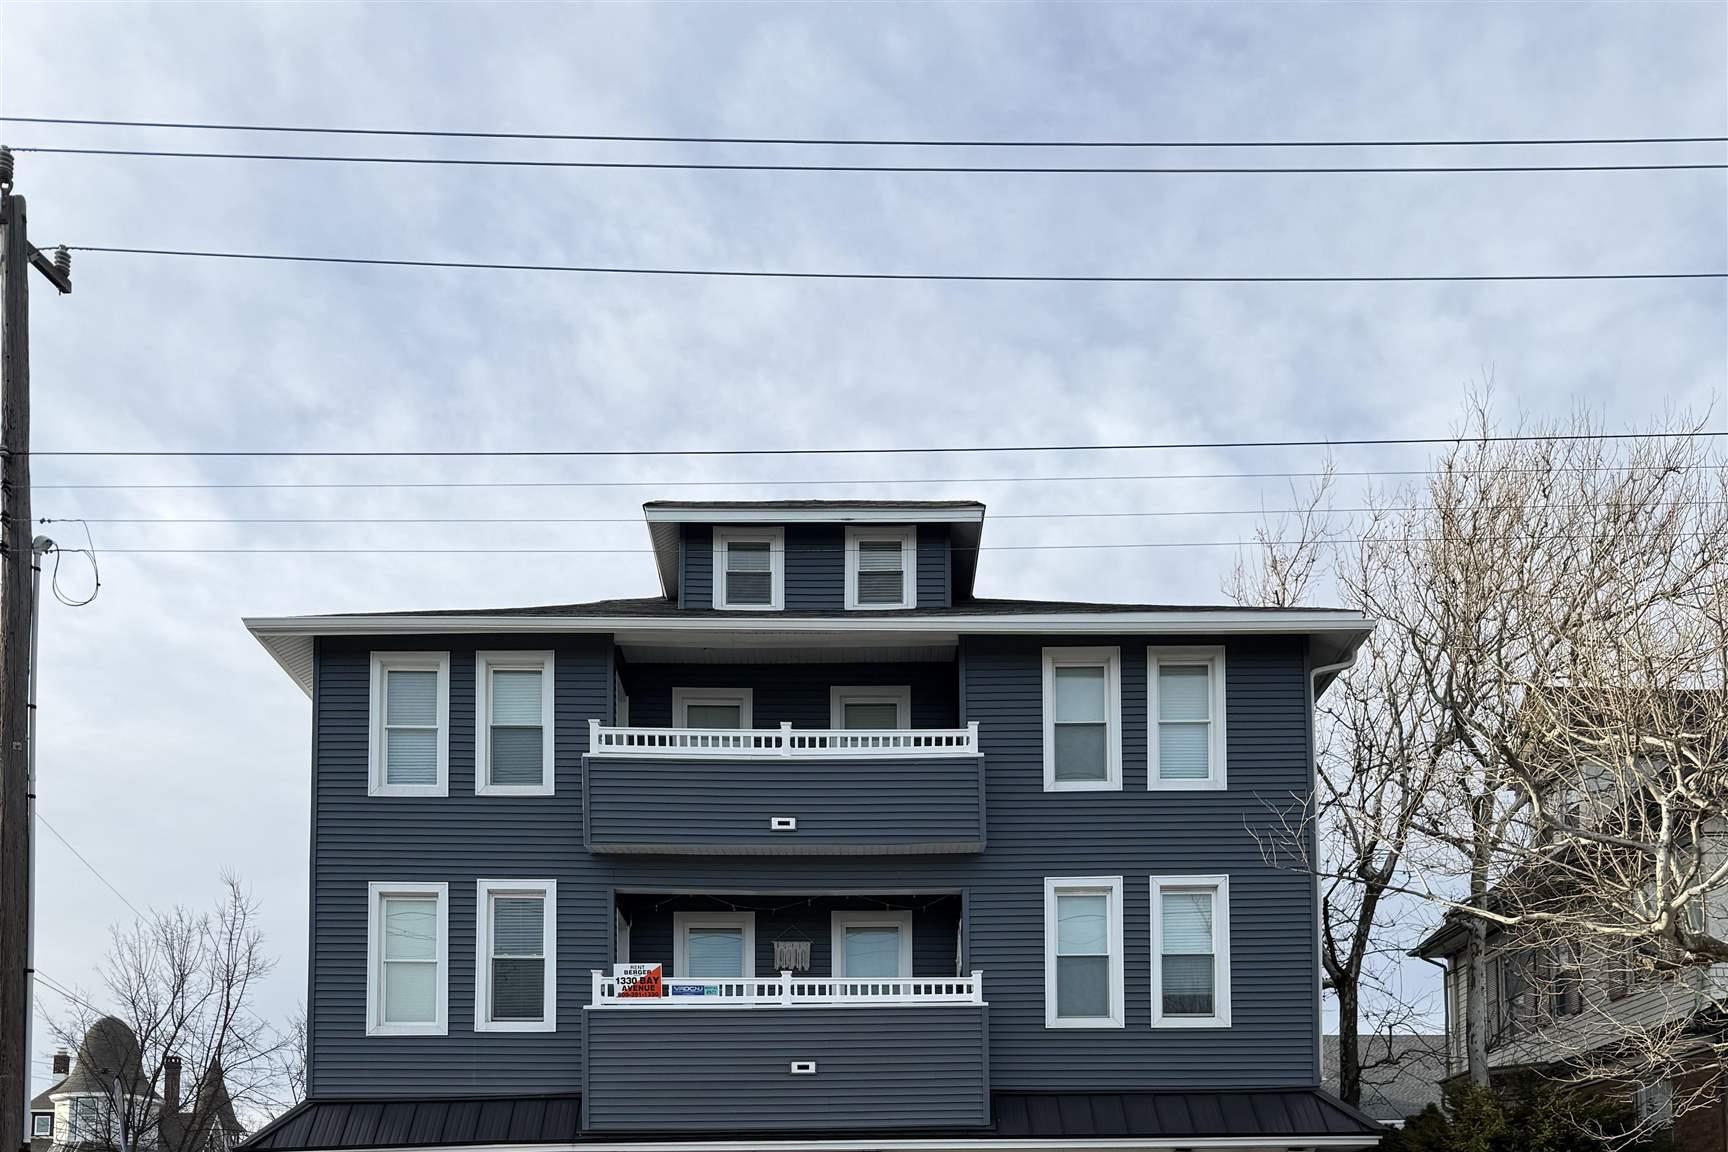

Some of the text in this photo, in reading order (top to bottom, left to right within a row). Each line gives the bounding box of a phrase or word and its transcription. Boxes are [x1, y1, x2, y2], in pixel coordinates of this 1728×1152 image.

[615, 976, 660, 985] 1330 BAY
[621, 984, 656, 992] AVENUE
